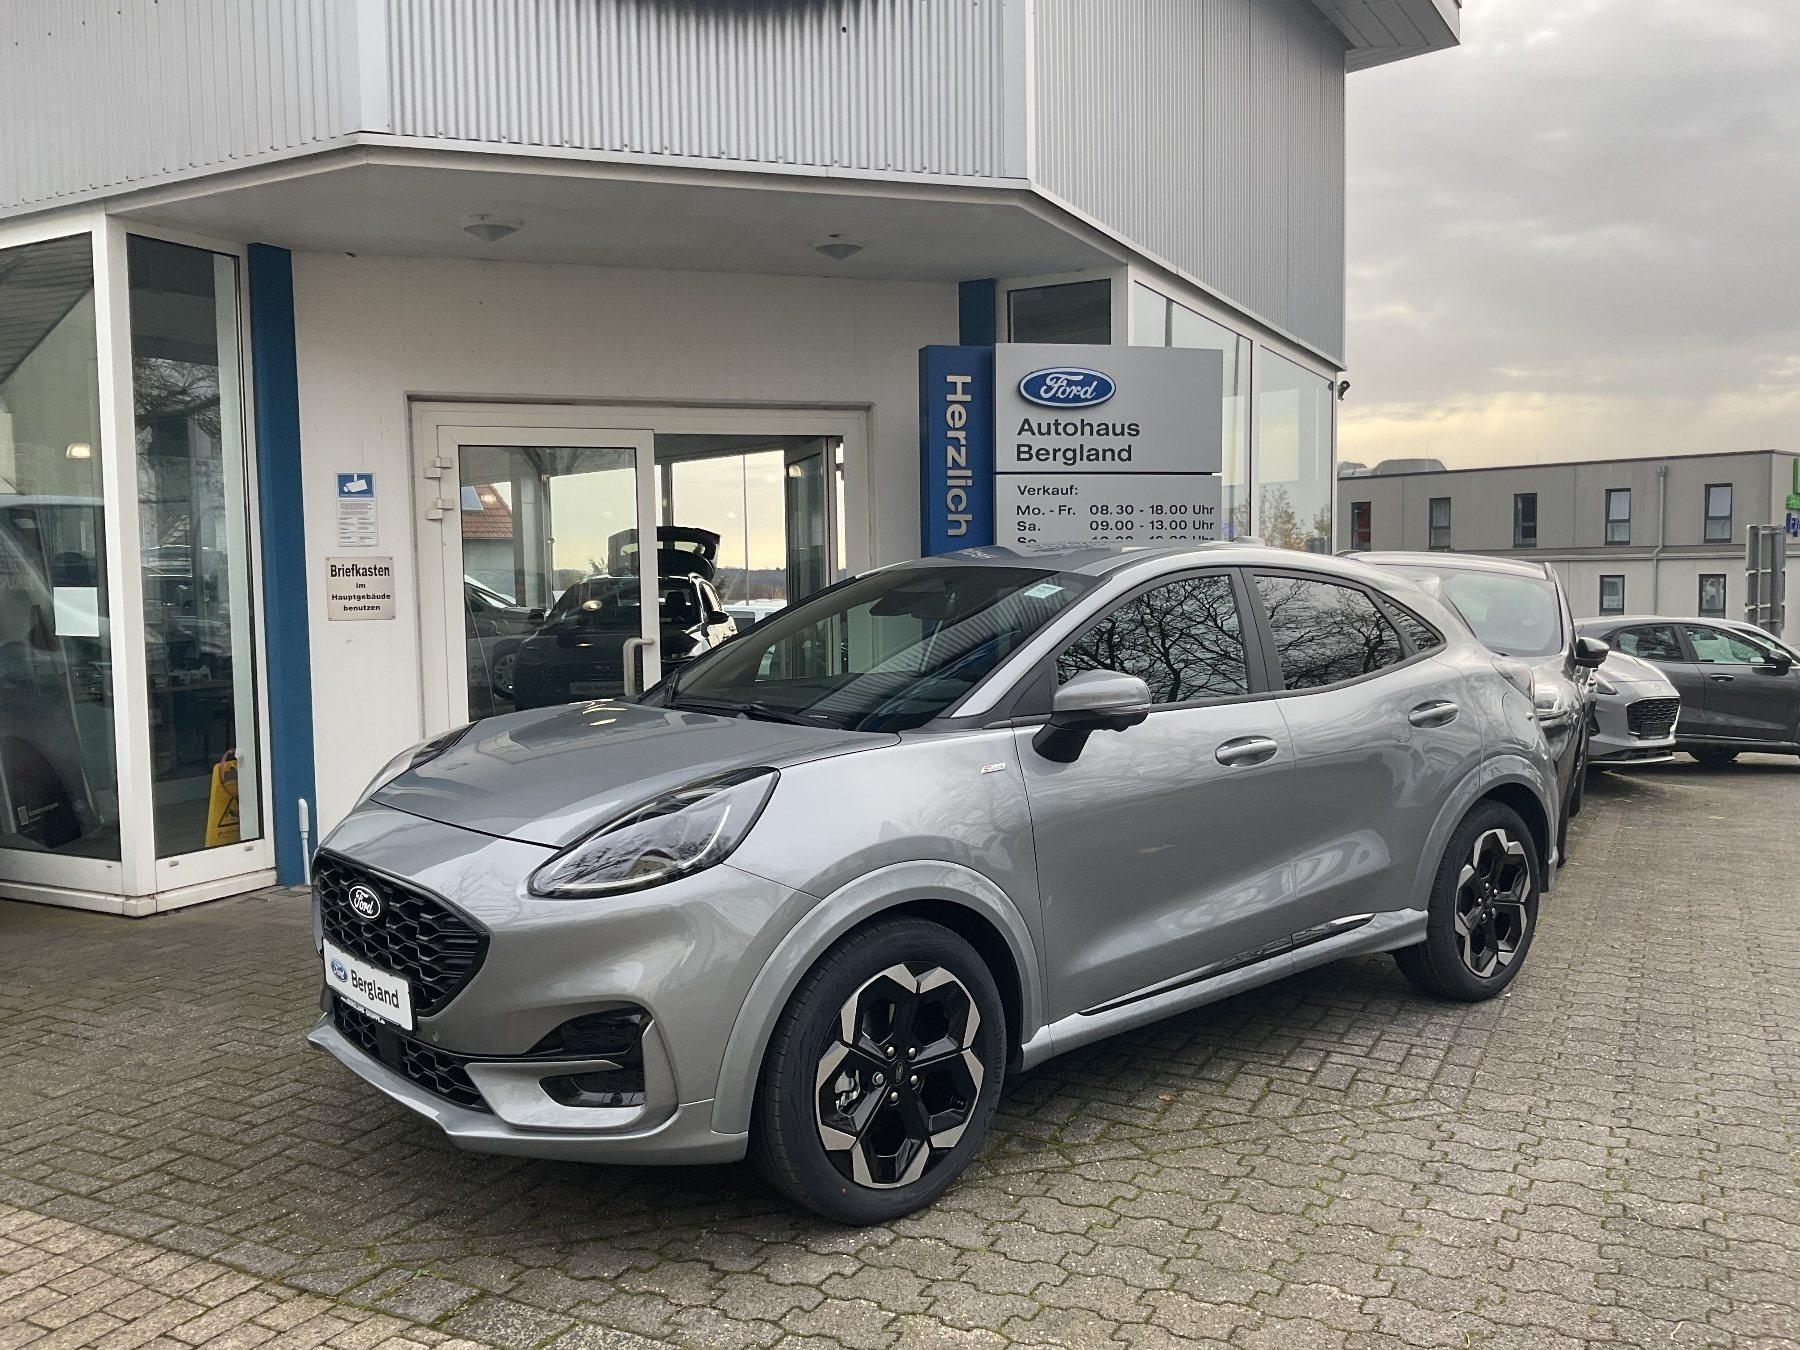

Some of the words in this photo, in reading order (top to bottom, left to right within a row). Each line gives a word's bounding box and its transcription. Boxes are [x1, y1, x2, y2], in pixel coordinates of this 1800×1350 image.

[1040, 373, 1098, 399] Ford
[1017, 418, 1140, 437] Autohaus
[946, 375, 973, 536] Herzlich
[1016, 444, 1132, 467] Bergland
[1017, 485, 1078, 496] Verkauf:
[1016, 505, 1045, 516] Mo.
[1058, 504, 1076, 516] Fr.
[1089, 504, 1134, 515] 08.30
[1149, 504, 1188, 515] 18.00
[1192, 504, 1214, 515] Uhr
[1017, 520, 1041, 532] Sa.
[1089, 520, 1134, 531] 09.00
[1149, 519, 1188, 530] 13.00
[1192, 519, 1214, 530] Uhr
[330, 564, 391, 578] Briefkasten
[331, 593, 391, 602] Hauptgebäude
[353, 889, 374, 915] Ford
[351, 969, 399, 1009] Bergland
